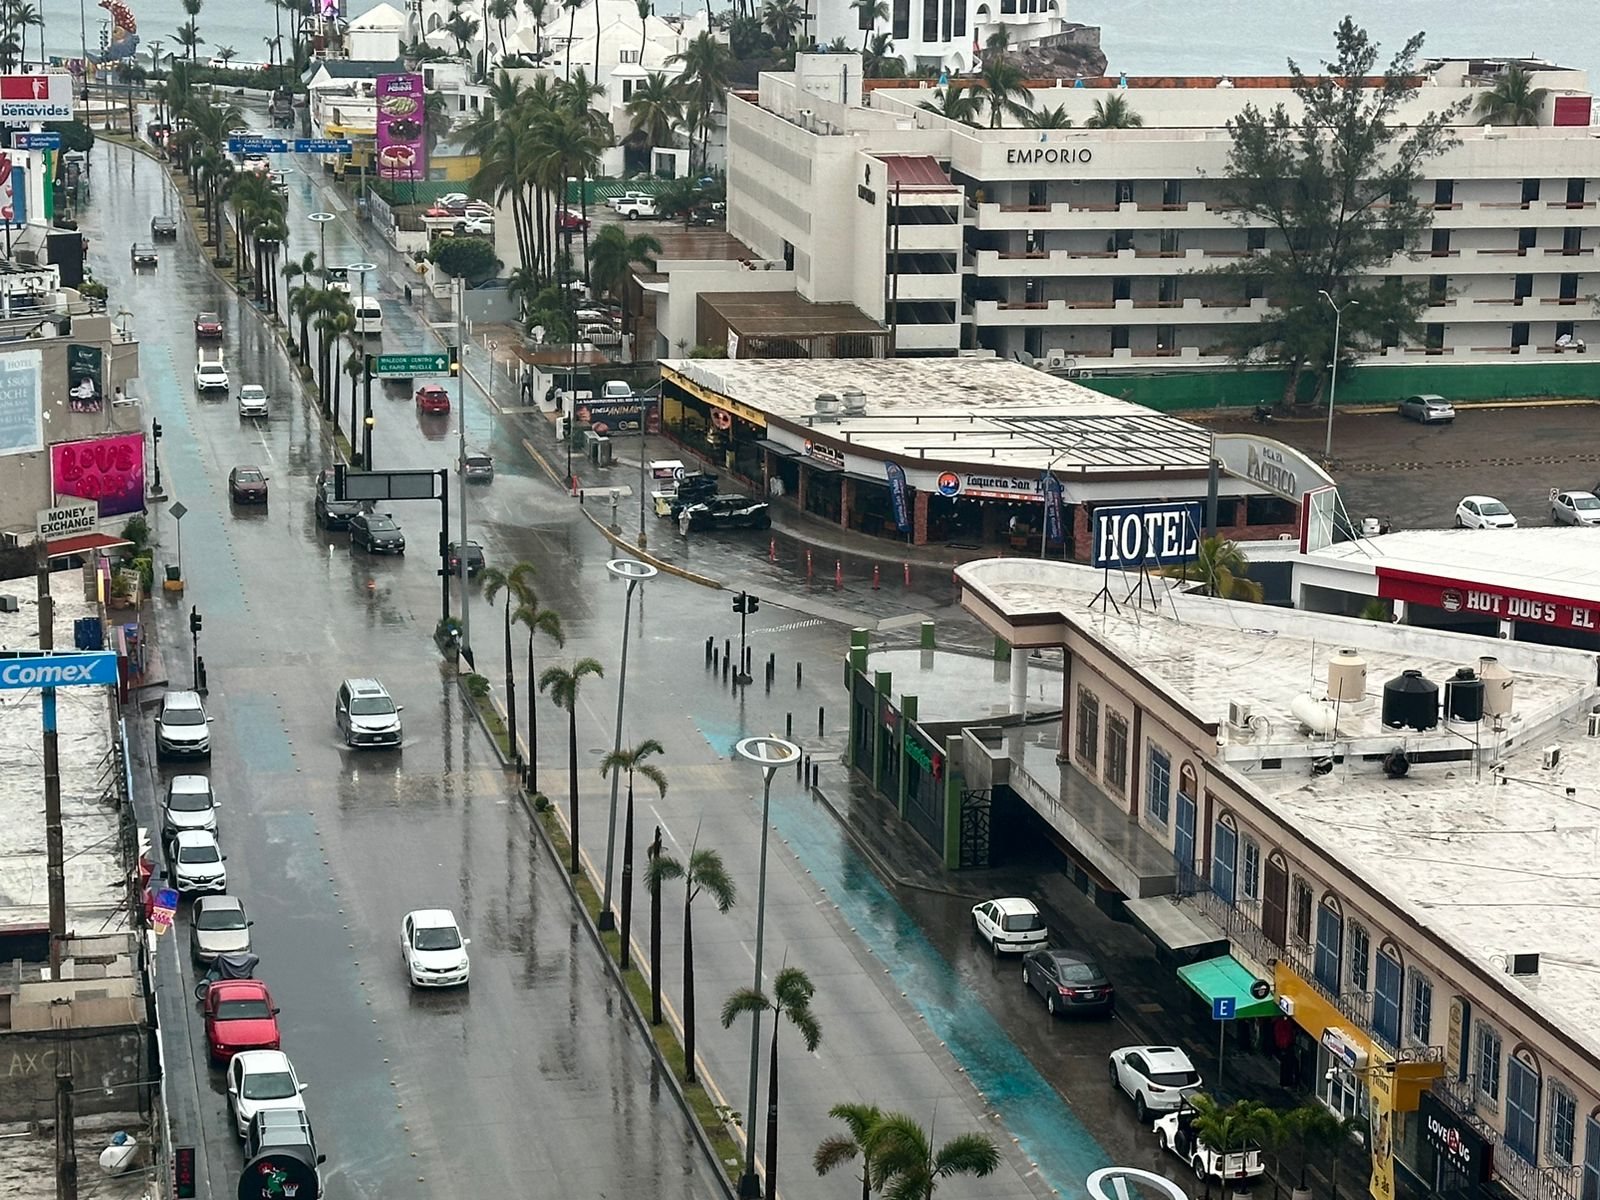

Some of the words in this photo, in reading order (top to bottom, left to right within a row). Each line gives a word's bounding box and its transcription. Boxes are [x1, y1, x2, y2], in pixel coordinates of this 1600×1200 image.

[1, 104, 70, 116] benavides
[1007, 149, 1092, 163] EMPORIO
[61, 444, 134, 482] LOVE
[1011, 477, 1030, 490] San
[48, 506, 87, 522] MONEY
[41, 516, 95, 533] EXCHANGE
[1097, 510, 1198, 562] HOTEL
[1466, 590, 1503, 613] HOT
[2, 659, 100, 684] Comex
[1220, 1000, 1229, 1016] E
